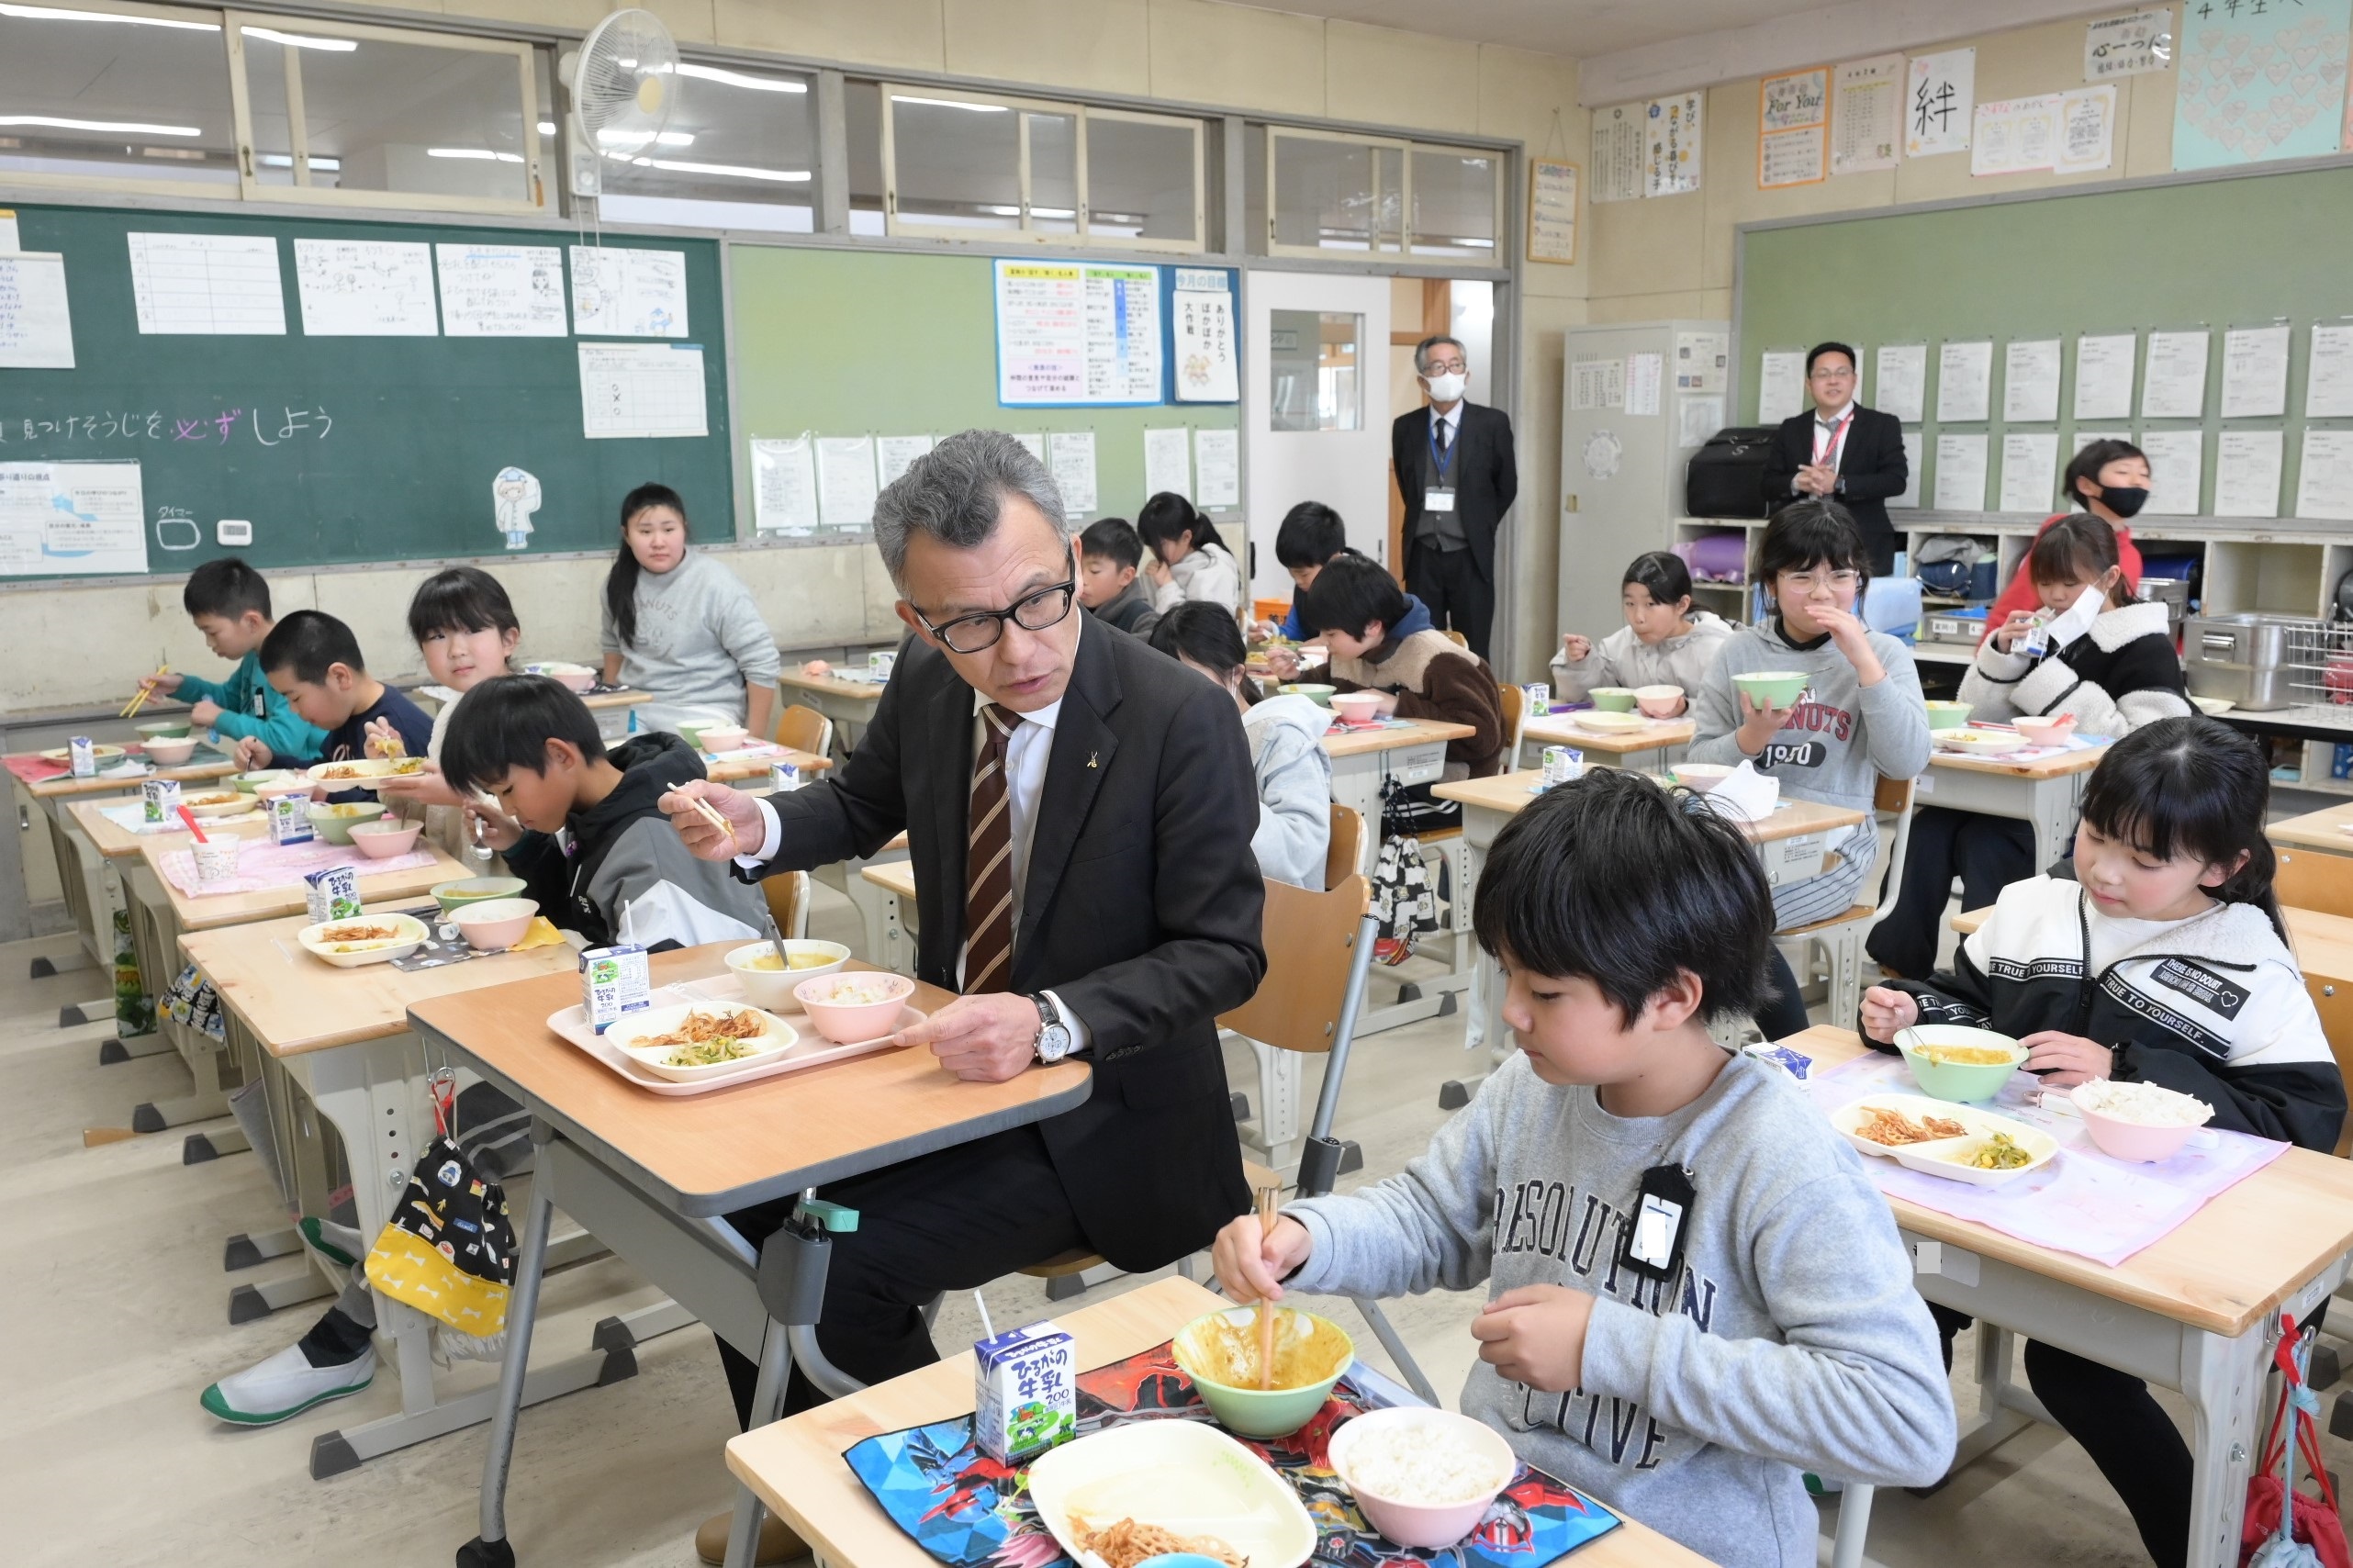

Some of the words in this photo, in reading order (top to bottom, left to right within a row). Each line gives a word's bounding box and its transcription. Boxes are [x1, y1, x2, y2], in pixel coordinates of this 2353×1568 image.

[1766, 98, 1791, 115] For
[1795, 94, 1821, 109] You
[1915, 77, 1958, 136] 絆
[1216, 304, 1227, 363] ありがとう
[1780, 703, 1852, 741] NUTS
[332, 881, 353, 896] 牛乳
[1998, 964, 2025, 978] TRUE
[2032, 963, 2084, 976] YOURSELF
[2167, 958, 2189, 974] THERE
[2189, 969, 2202, 980] NO
[2198, 973, 2223, 991] DOUBT
[2104, 975, 2127, 998] TRUE
[2127, 993, 2146, 1009] TO
[1011, 1348, 1068, 1380] ひるがの
[1018, 1369, 1063, 1399] 牛乳
[1046, 1388, 1070, 1405] 200
